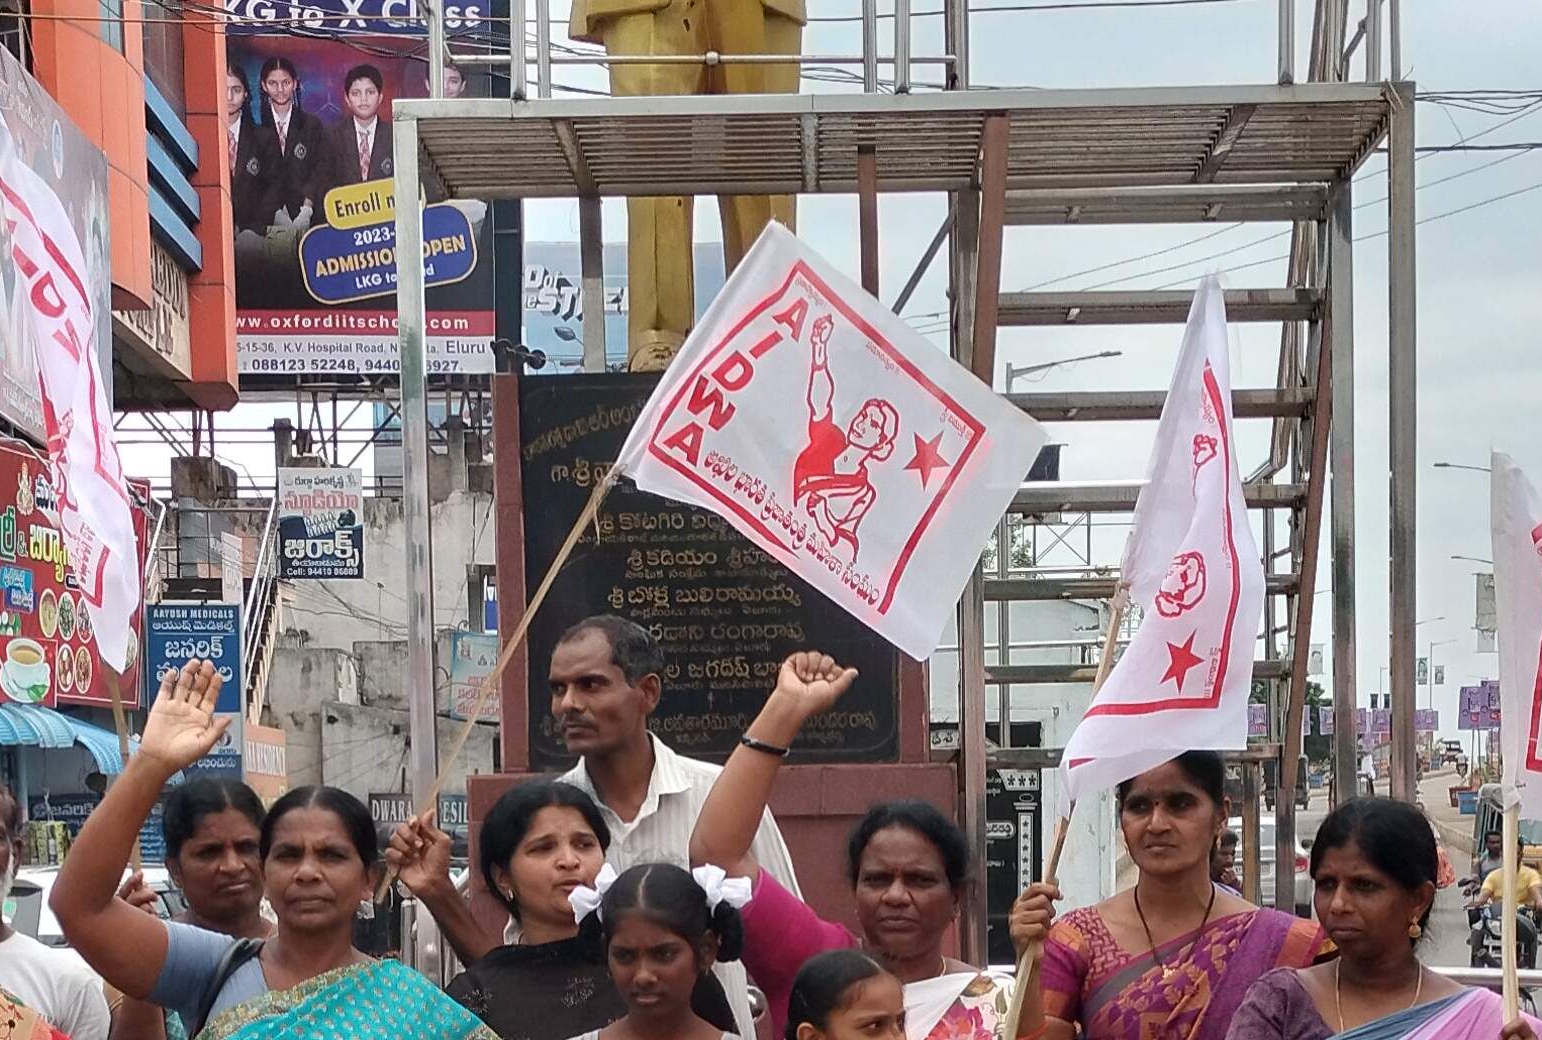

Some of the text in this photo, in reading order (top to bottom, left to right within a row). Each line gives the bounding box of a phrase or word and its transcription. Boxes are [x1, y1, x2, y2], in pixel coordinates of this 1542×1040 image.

[334, 191, 381, 219] Enroll
[353, 227, 397, 246] 2023-
[315, 245, 397, 278] ADMISSIO
[355, 273, 382, 290] LKG
[307, 342, 353, 356] Hospital
[356, 342, 386, 356] Road,
[445, 340, 485, 355] Eluru
[251, 358, 360, 373] 088123 52248,
[663, 297, 809, 467] AIDWA
[153, 609, 234, 620] AAYUSH MEDICALS
